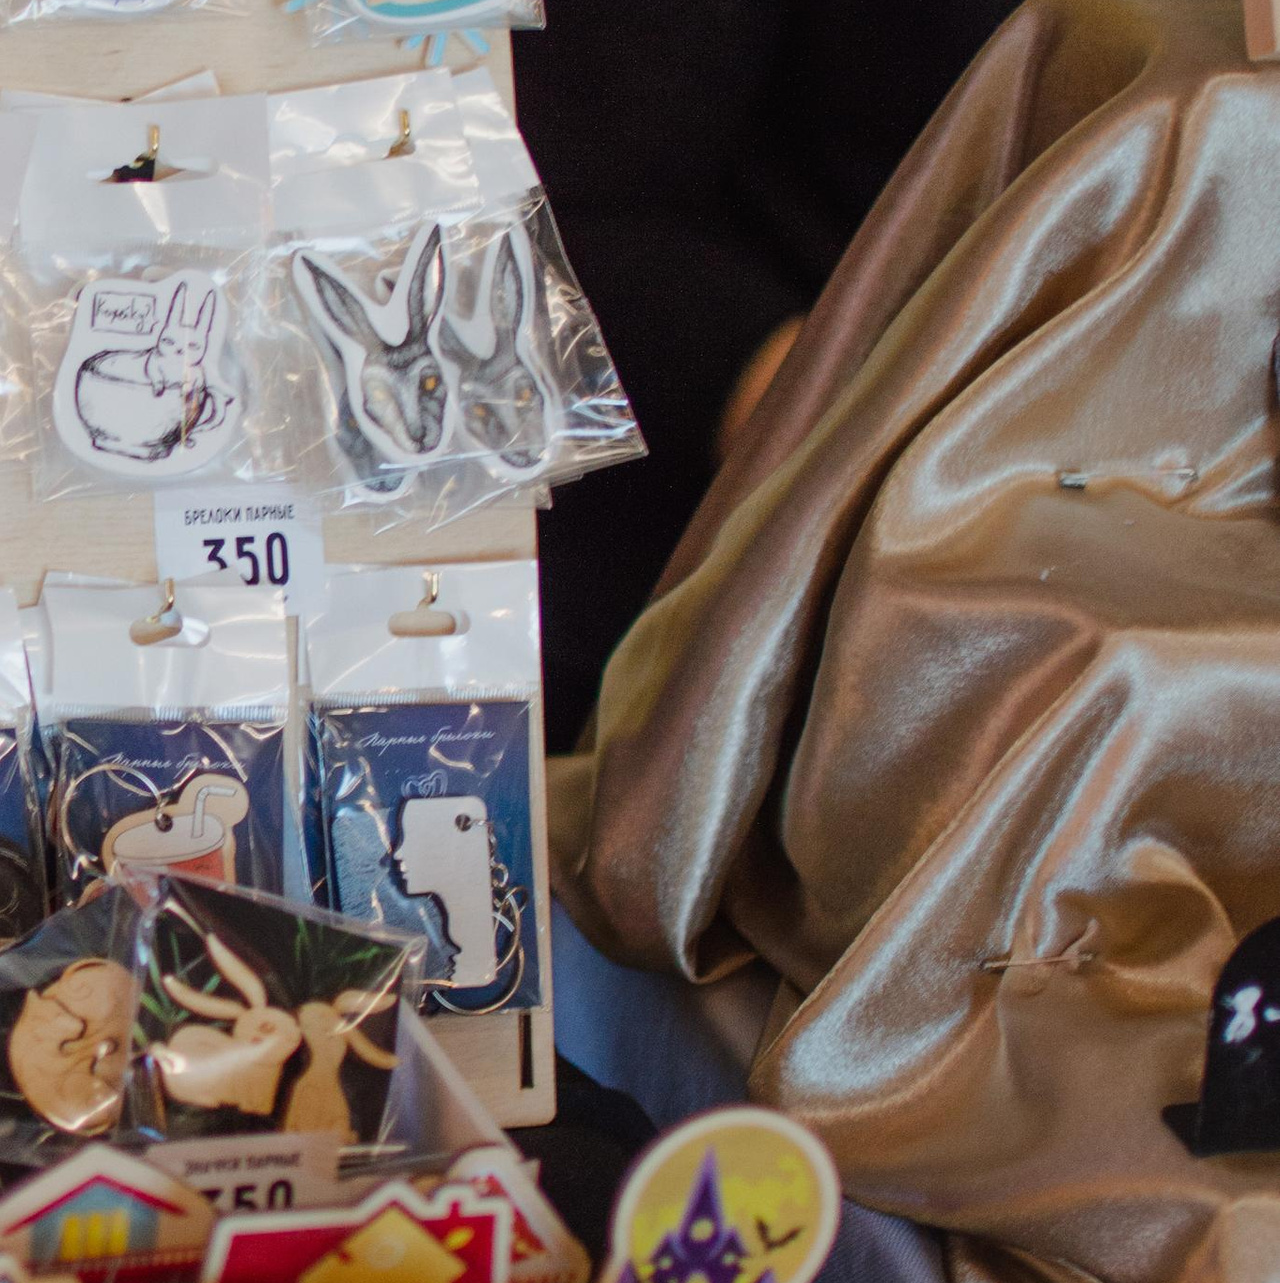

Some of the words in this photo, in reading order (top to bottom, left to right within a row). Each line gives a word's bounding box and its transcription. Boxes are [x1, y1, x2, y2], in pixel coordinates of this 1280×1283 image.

[184, 506, 241, 526] БРЕЛОКИ
[245, 504, 295, 522] ПАРНЫЕ
[203, 532, 289, 587] 350
